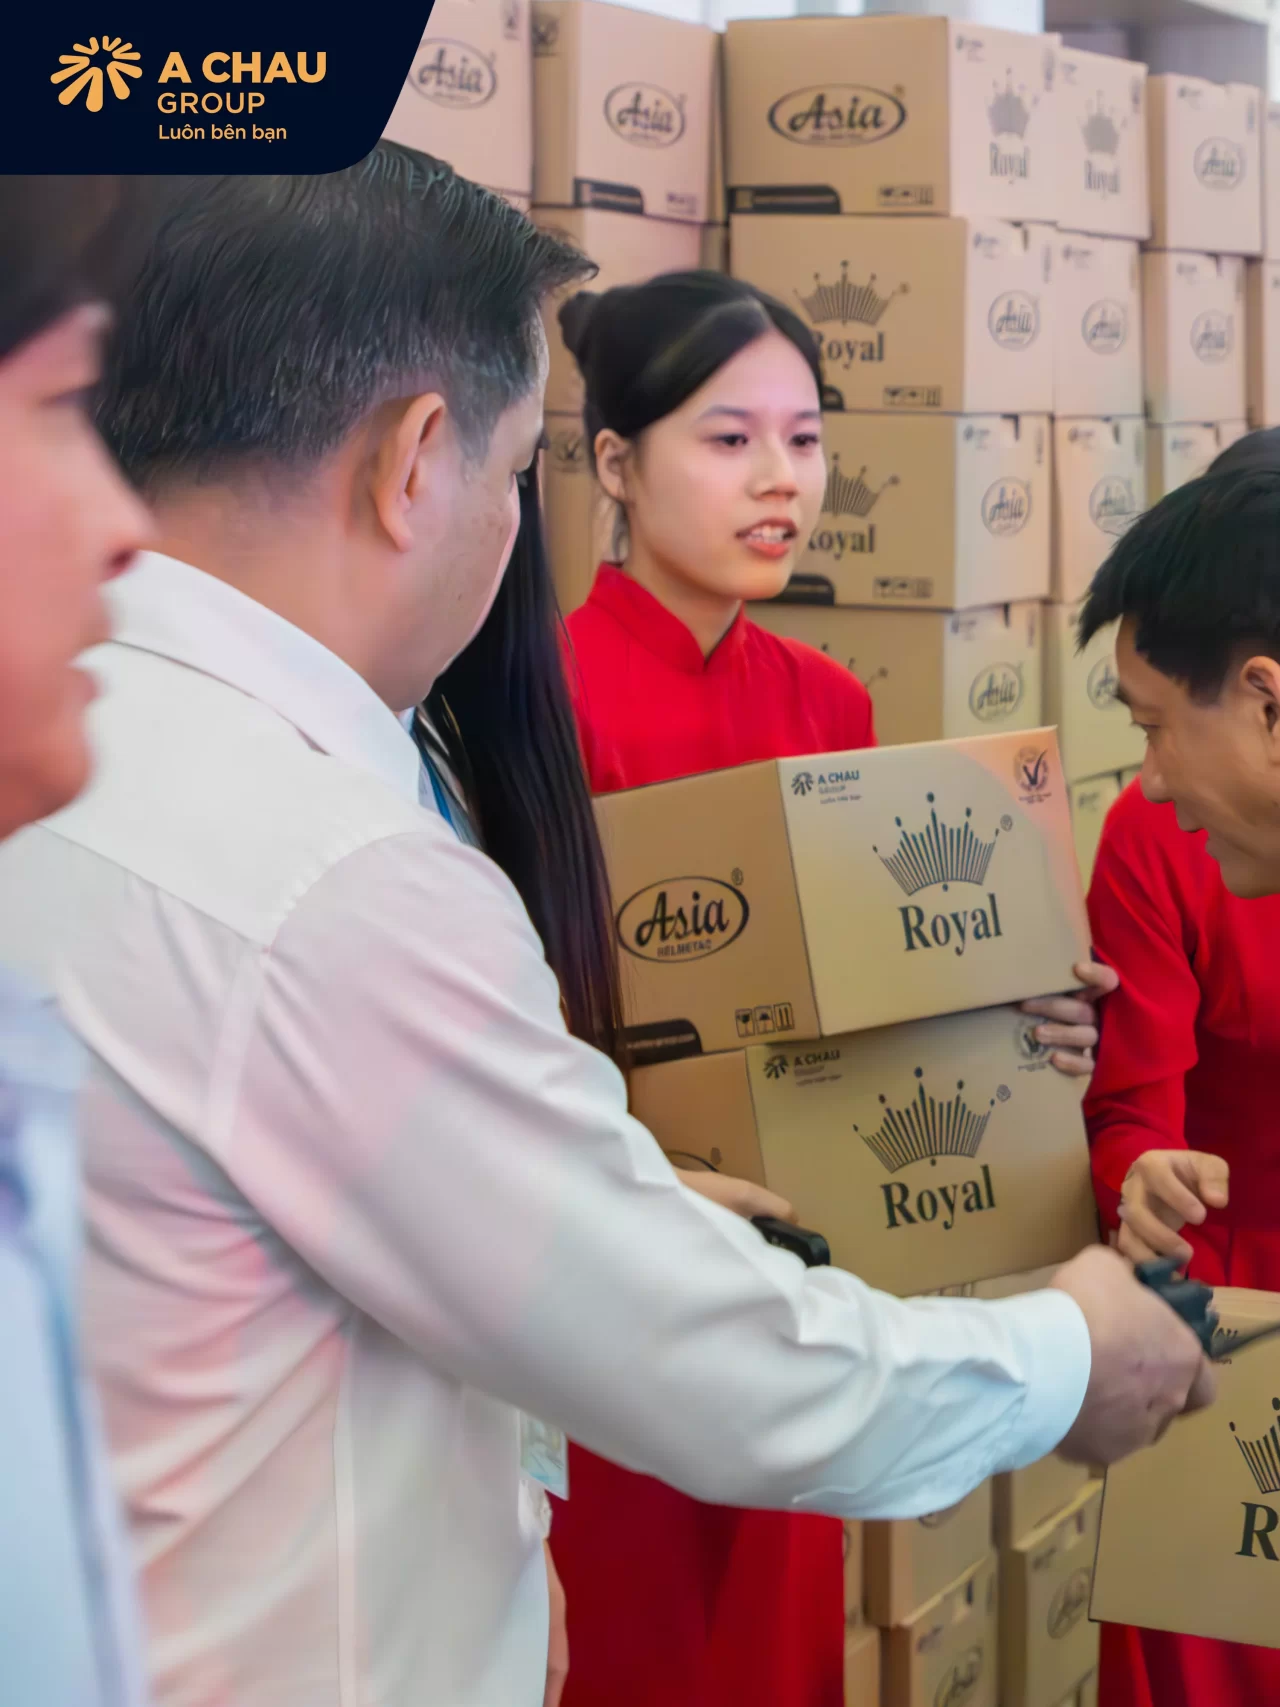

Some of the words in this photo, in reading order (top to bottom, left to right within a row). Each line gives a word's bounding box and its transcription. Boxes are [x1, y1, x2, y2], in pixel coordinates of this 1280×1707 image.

[787, 92, 885, 133] Asia
[634, 890, 731, 948] Asia
[897, 892, 1003, 957] Royal
[880, 1164, 997, 1230] Royal
